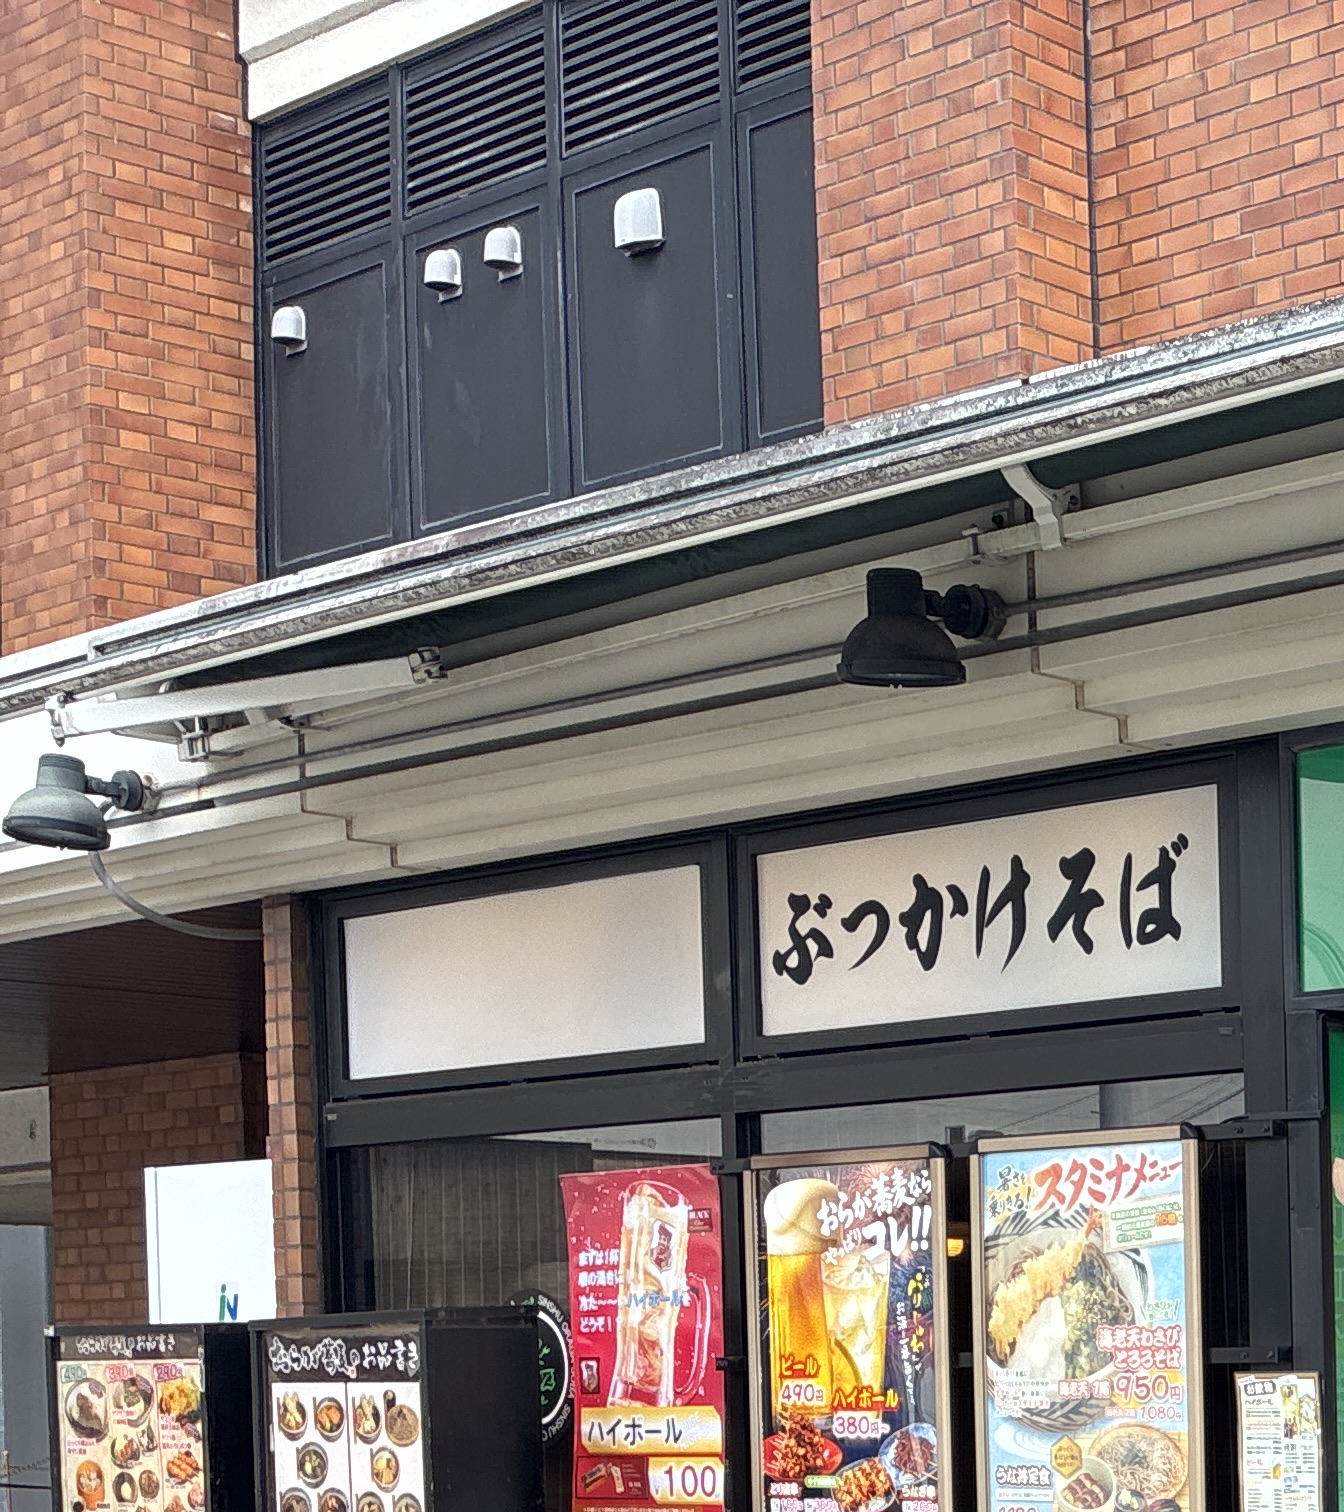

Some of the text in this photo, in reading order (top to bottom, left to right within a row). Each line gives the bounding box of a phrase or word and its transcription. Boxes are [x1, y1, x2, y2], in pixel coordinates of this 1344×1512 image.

[1031, 1152, 1182, 1213] スタミナメニュー
[780, 1355, 820, 1379] ビール
[832, 1388, 899, 1409] ハイボール
[587, 1416, 683, 1447] ハイボール
